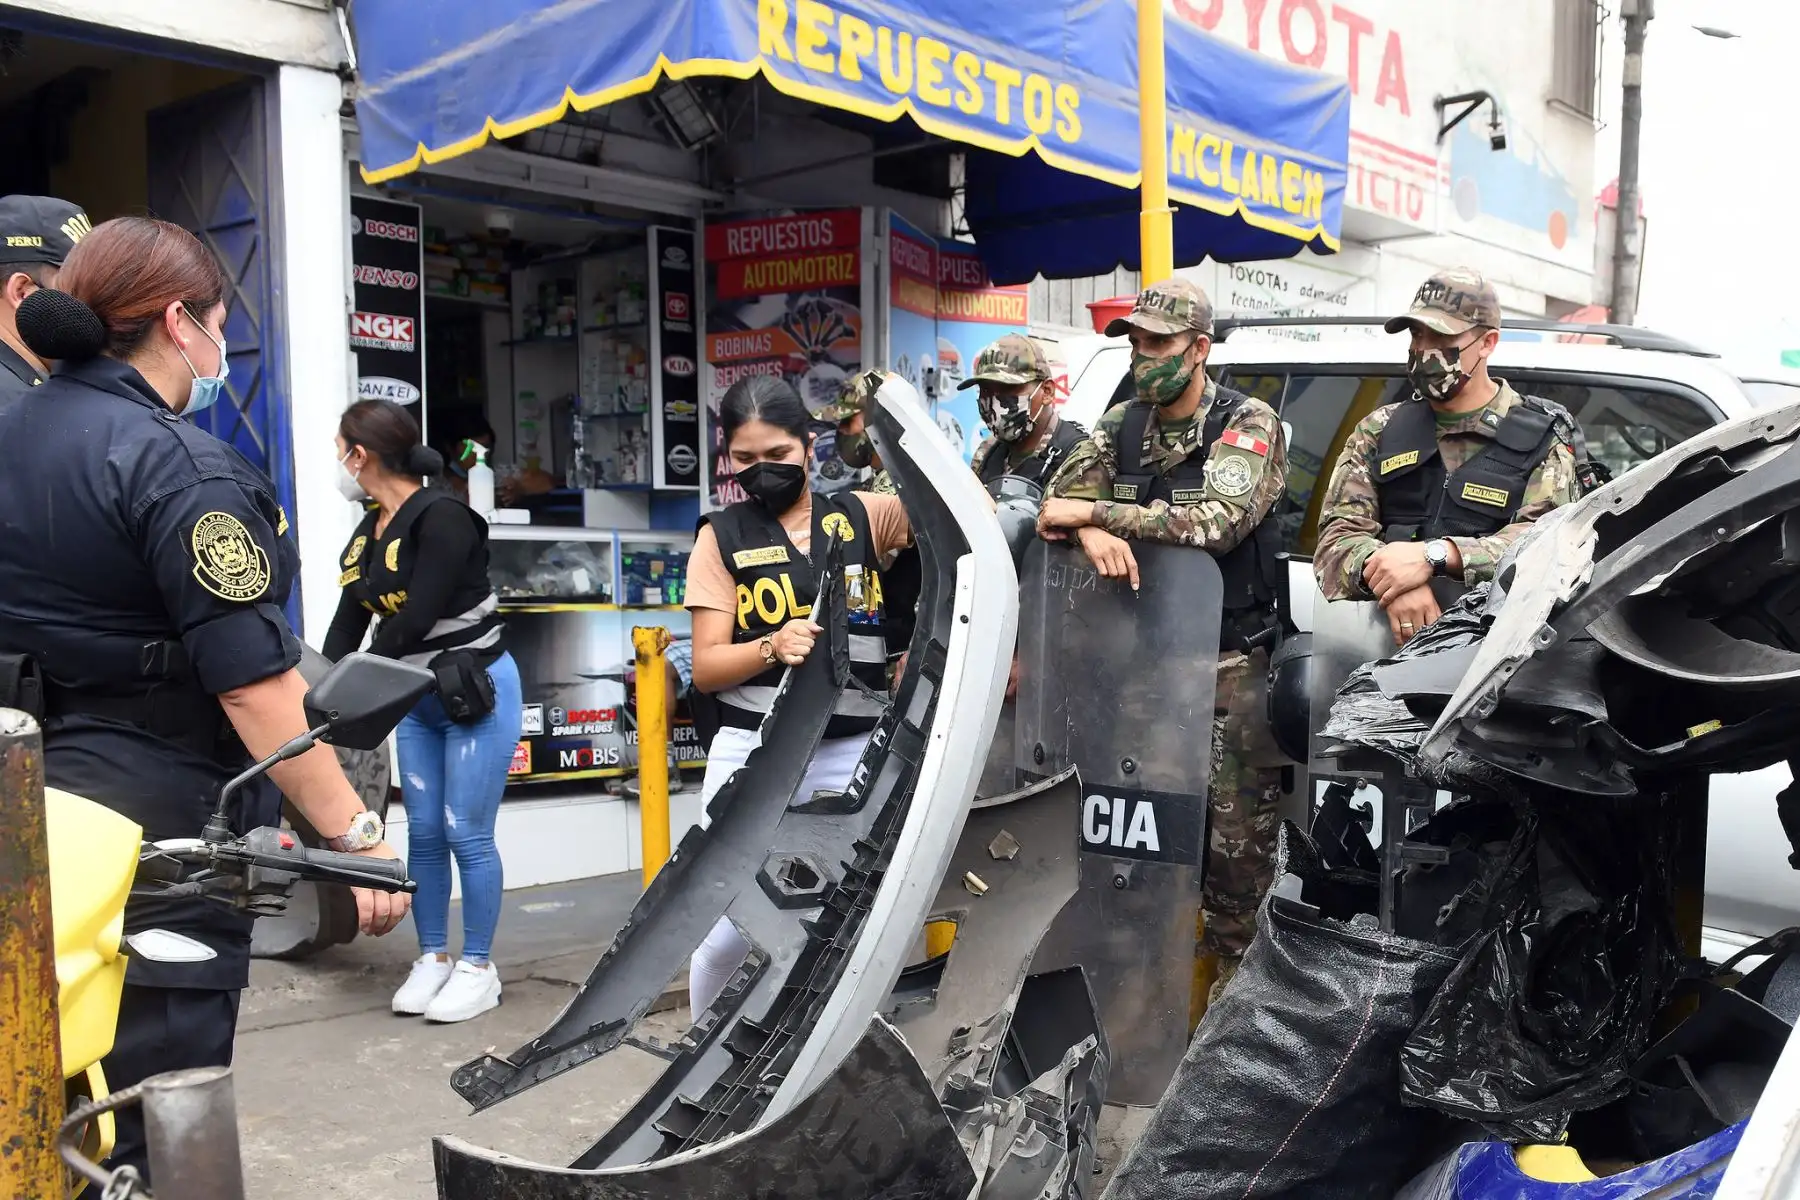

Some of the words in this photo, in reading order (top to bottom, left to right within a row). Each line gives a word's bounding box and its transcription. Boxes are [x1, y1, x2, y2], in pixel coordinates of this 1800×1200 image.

[757, 0, 1082, 143] REPUESTOS
[366, 220, 417, 241] BOSCH
[727, 220, 834, 255] REPUESTOS
[6, 236, 42, 248] PERU
[744, 253, 855, 290] AUTOMOTRIZ
[938, 289, 1024, 321] AUTOMOTRIZ
[352, 314, 411, 341] NGK
[715, 334, 772, 358] BOBINAS
[668, 359, 691, 373] KIA
[567, 708, 616, 724] BOSCH
[552, 725, 582, 736] SPARK
[584, 723, 613, 734] PLUGS
[560, 747, 620, 768] MOBIS
